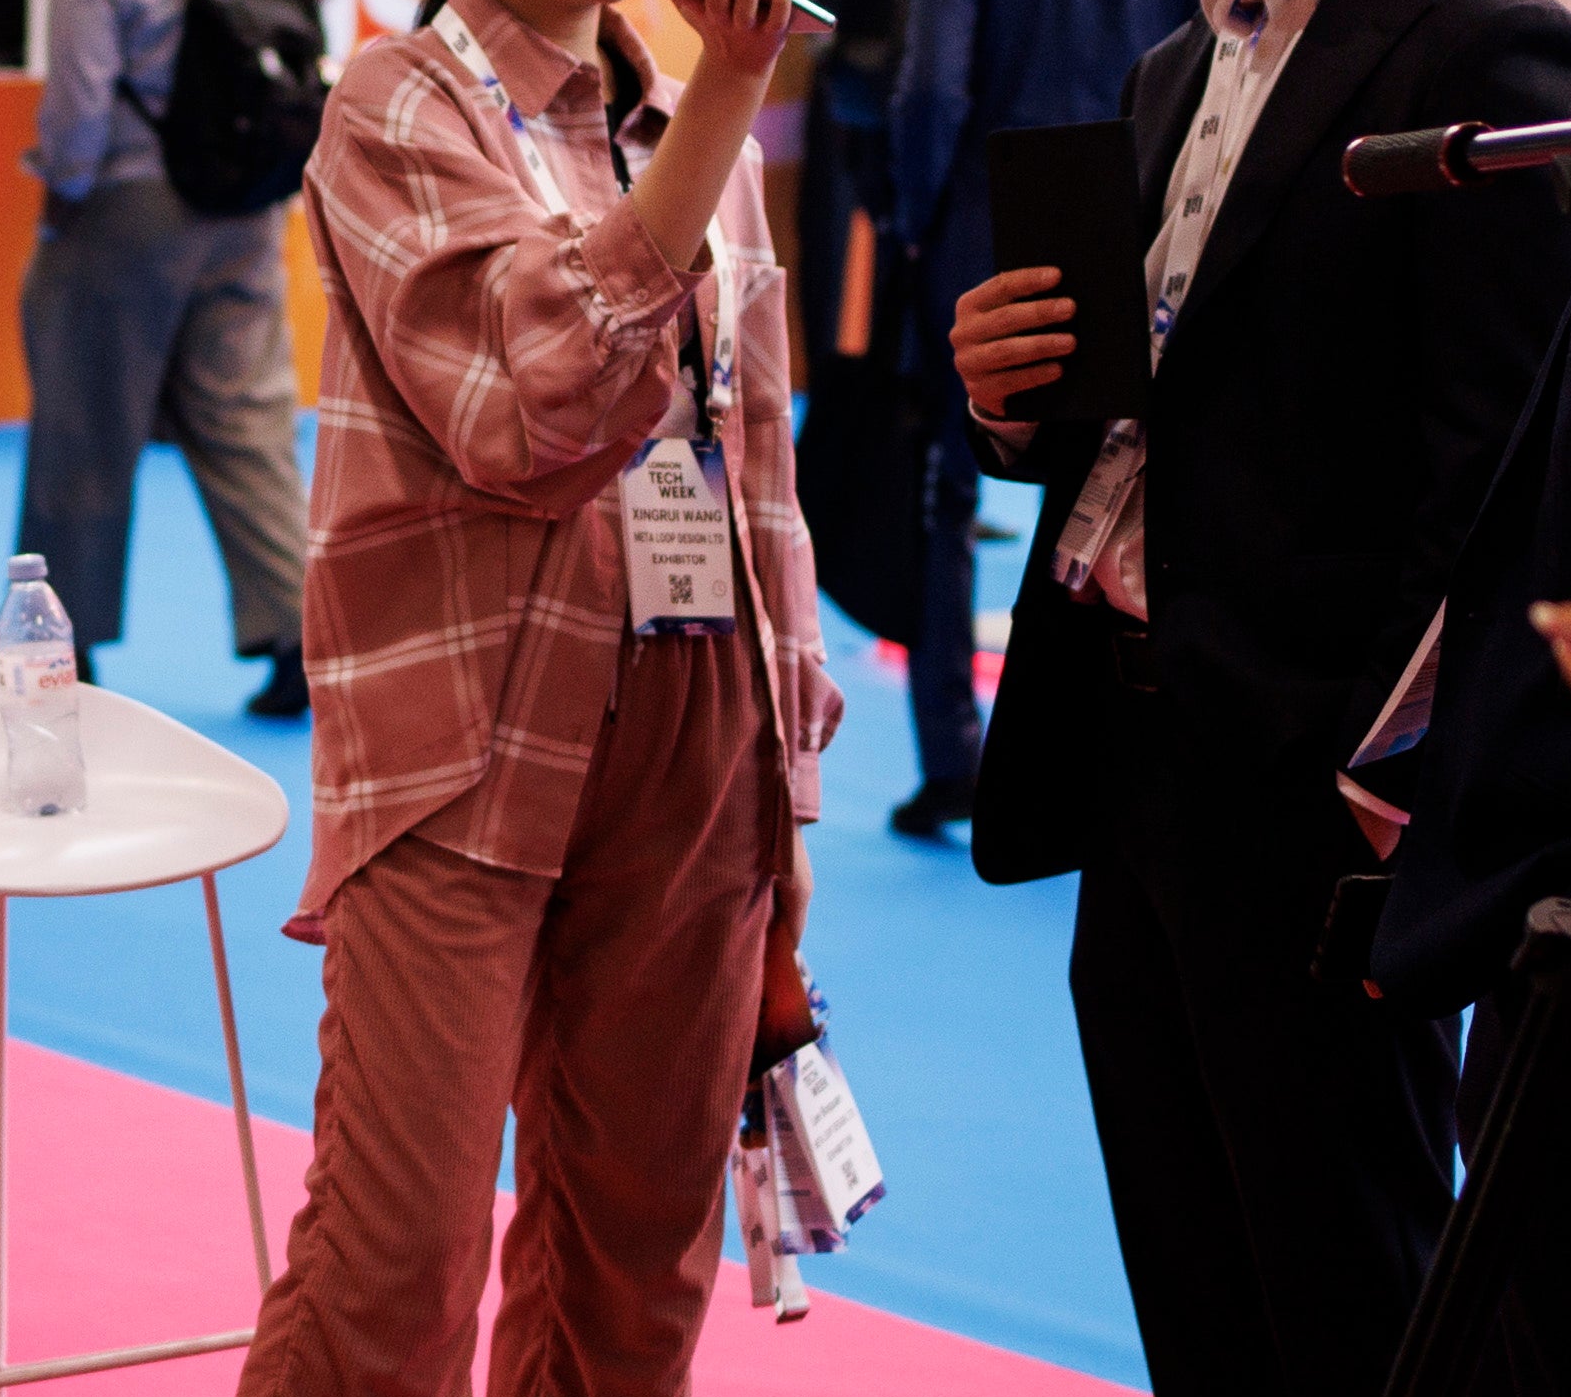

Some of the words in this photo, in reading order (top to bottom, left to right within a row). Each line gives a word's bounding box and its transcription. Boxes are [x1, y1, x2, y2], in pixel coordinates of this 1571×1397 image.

[648, 471, 684, 485] TECH
[659, 486, 696, 499] WEEK
[683, 510, 723, 523] WANG
[652, 554, 707, 565] EXHIBITOR
